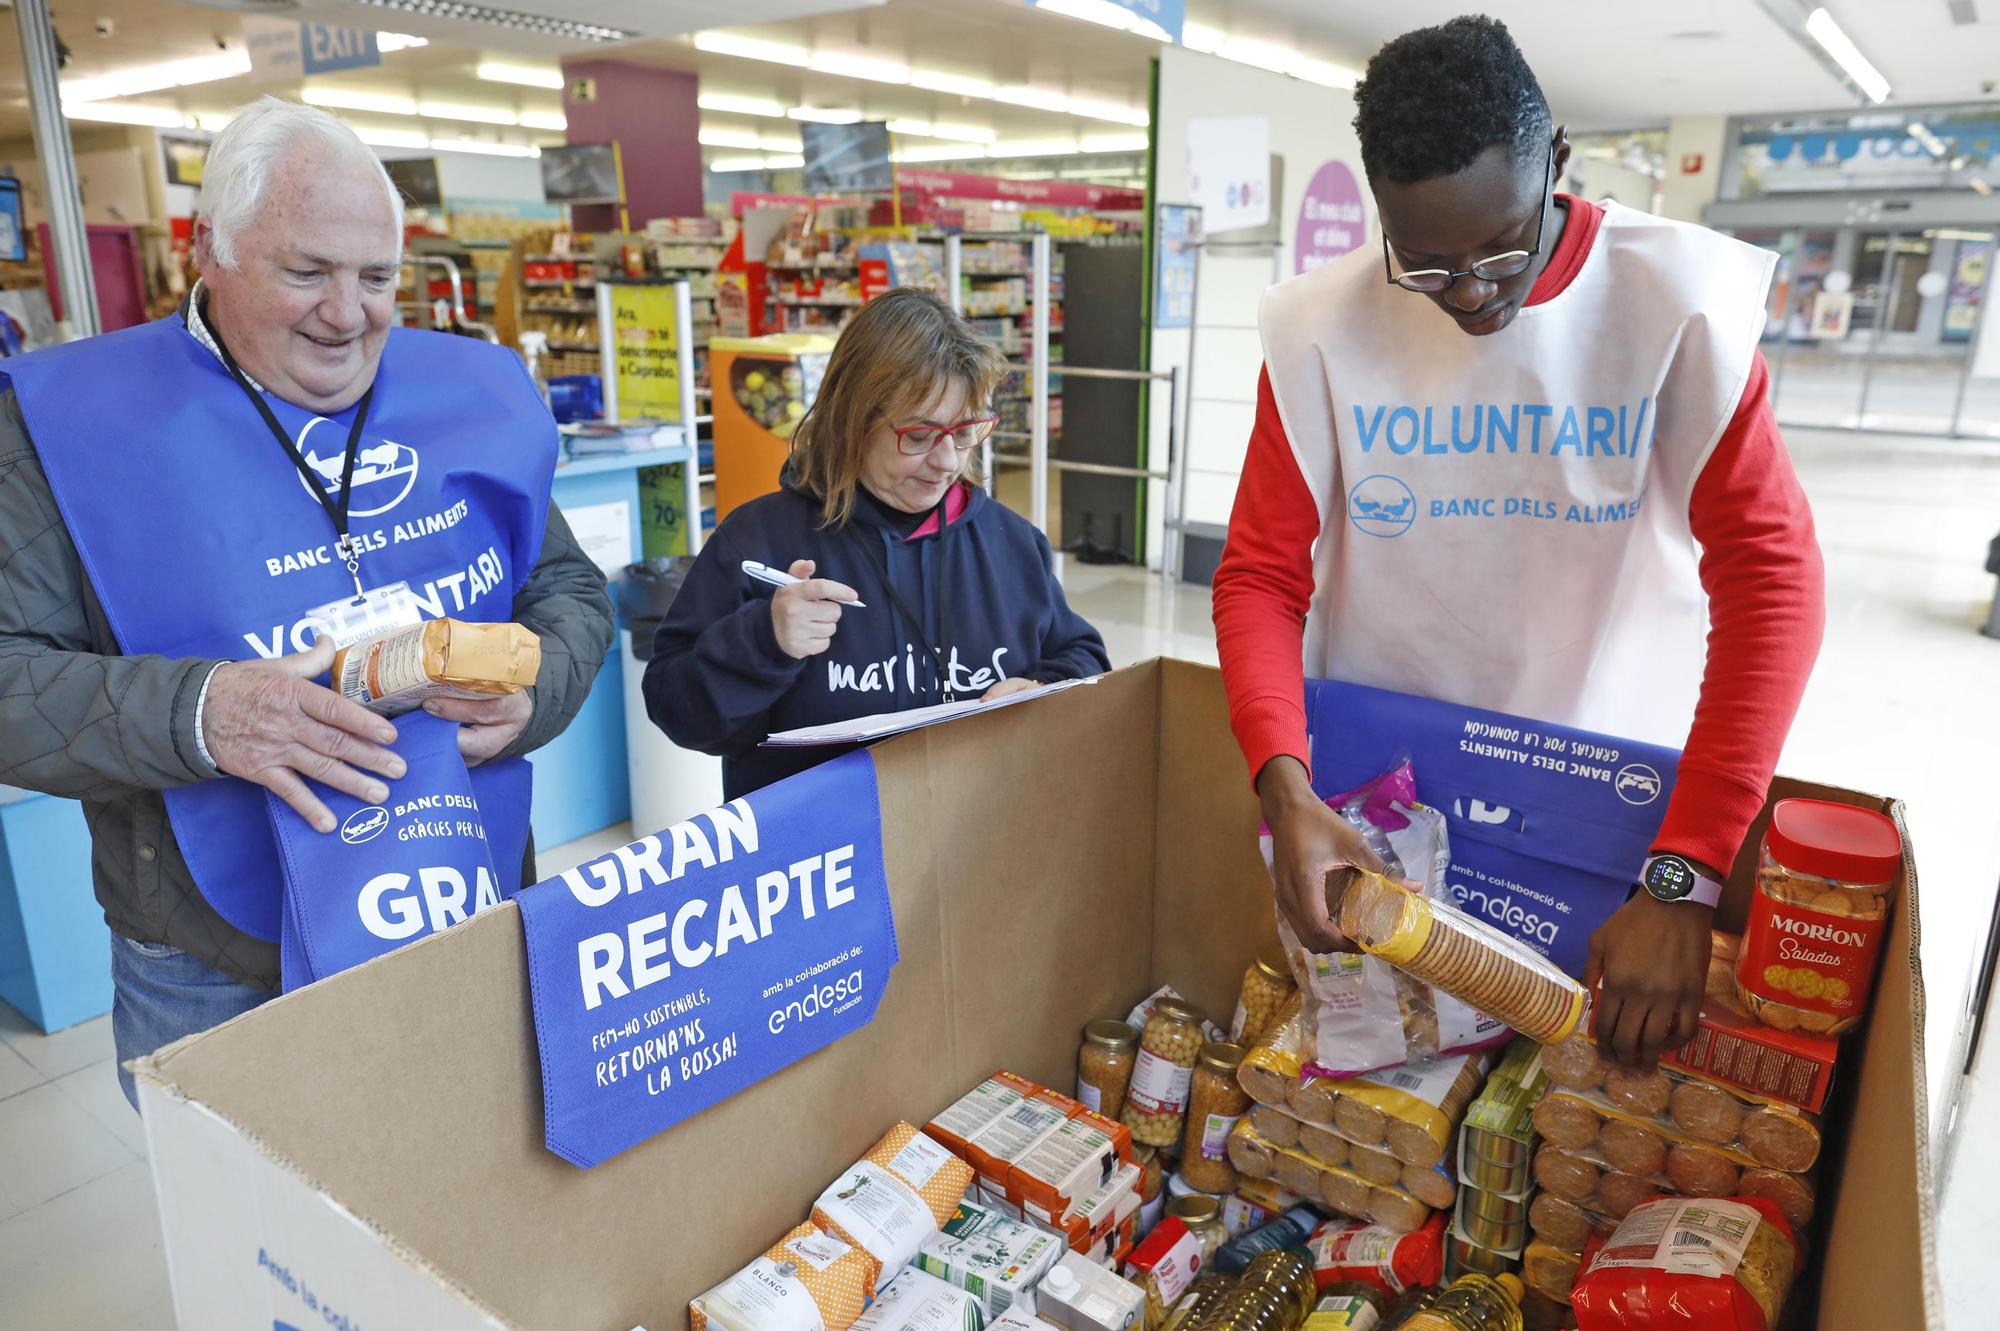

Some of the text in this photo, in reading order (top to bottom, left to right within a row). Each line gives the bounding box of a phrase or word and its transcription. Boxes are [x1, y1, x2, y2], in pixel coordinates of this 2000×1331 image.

[308, 23, 367, 62] EXIT
[1353, 397, 1655, 458] VOLUNTARI/
[1429, 498, 1495, 518] BANC
[1503, 497, 1557, 520] DELS
[265, 498, 469, 577] BANC DELS ALIMENTS
[1459, 739, 1612, 783] BANC DELS ALIMENTS
[1464, 719, 1620, 763] GRACIAS POR LA DONACIÓN
[394, 795, 442, 817] BANC
[444, 794, 472, 809] DELS
[398, 817, 453, 842] GRÀCIES
[456, 821, 474, 838] PER
[559, 797, 759, 908] GRAN
[1663, 866, 1675, 879] 43
[1673, 870, 1684, 882] 13
[357, 866, 502, 940] GRA
[1450, 863, 1572, 915] amb la col·laboració de:
[578, 844, 855, 1011] RECAPTE
[1450, 884, 1559, 945] endesa
[1770, 913, 1867, 947] MORION
[762, 945, 863, 999] amb la col·laboració de:
[1779, 937, 1841, 965] Saladas
[591, 987, 712, 1053] FEM-HO SOSTENIBLE,
[768, 969, 863, 1034] endesa
[833, 995, 863, 1016] Fundación
[595, 1017, 706, 1088] RETORNA'NS
[647, 1031, 738, 1096] LA BOSSA!
[954, 1211, 979, 1236] CATALUNYA
[258, 1248, 297, 1294] Amb
[301, 1279, 319, 1311] la
[752, 1268, 788, 1297] BLANCO
